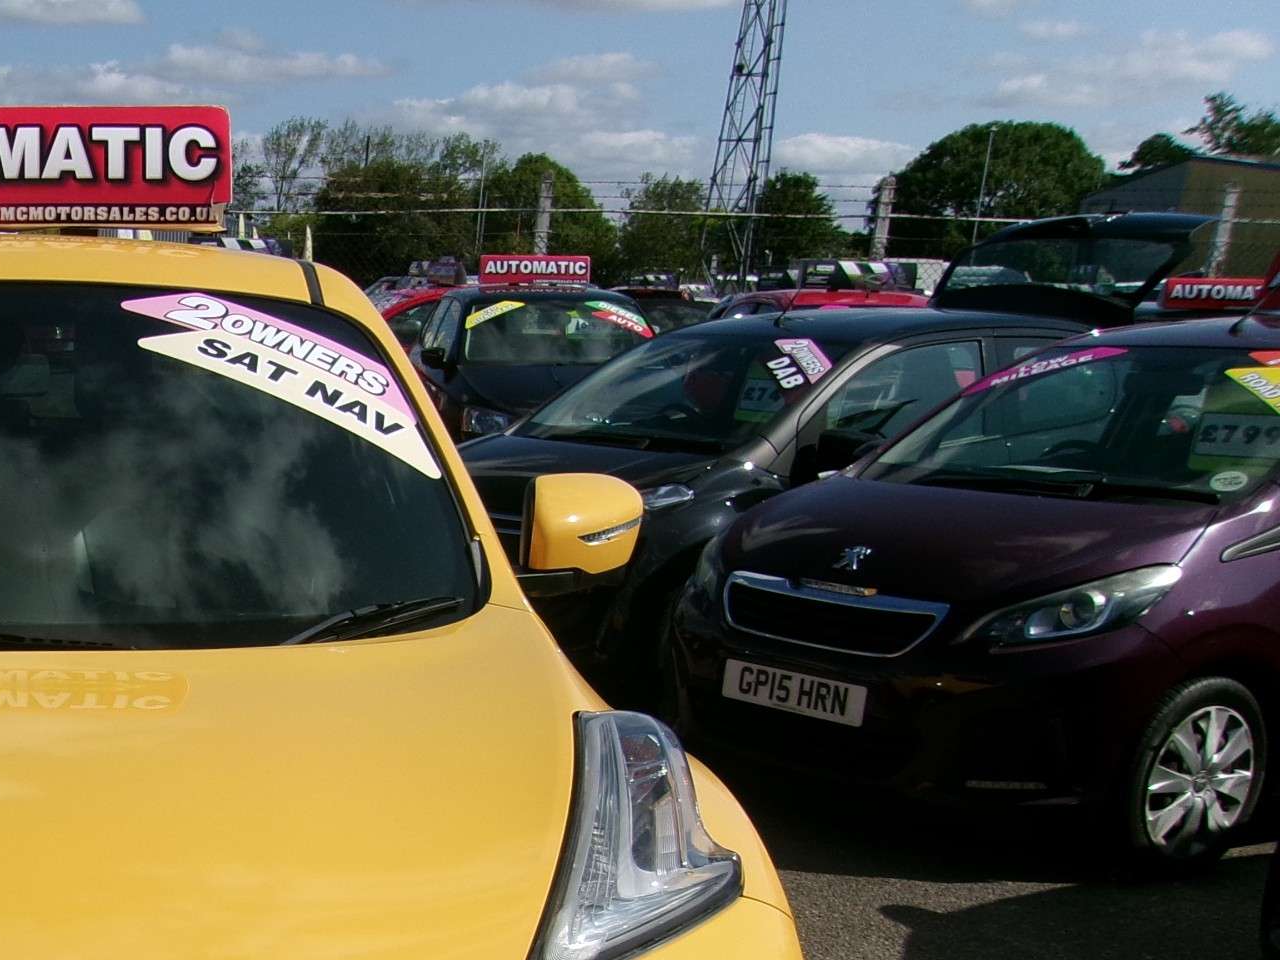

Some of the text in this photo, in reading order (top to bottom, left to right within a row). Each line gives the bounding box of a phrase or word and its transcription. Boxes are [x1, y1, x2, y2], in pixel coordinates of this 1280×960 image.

[485, 260, 587, 275] AUTOMATIC
[1170, 284, 1262, 300] AUTOMA
[608, 314, 643, 332] AUTO
[220, 313, 390, 397] OWNERS
[197, 338, 406, 436] SAT NAV
[766, 356, 805, 389] DAB
[738, 665, 849, 717] GP15 HRN
